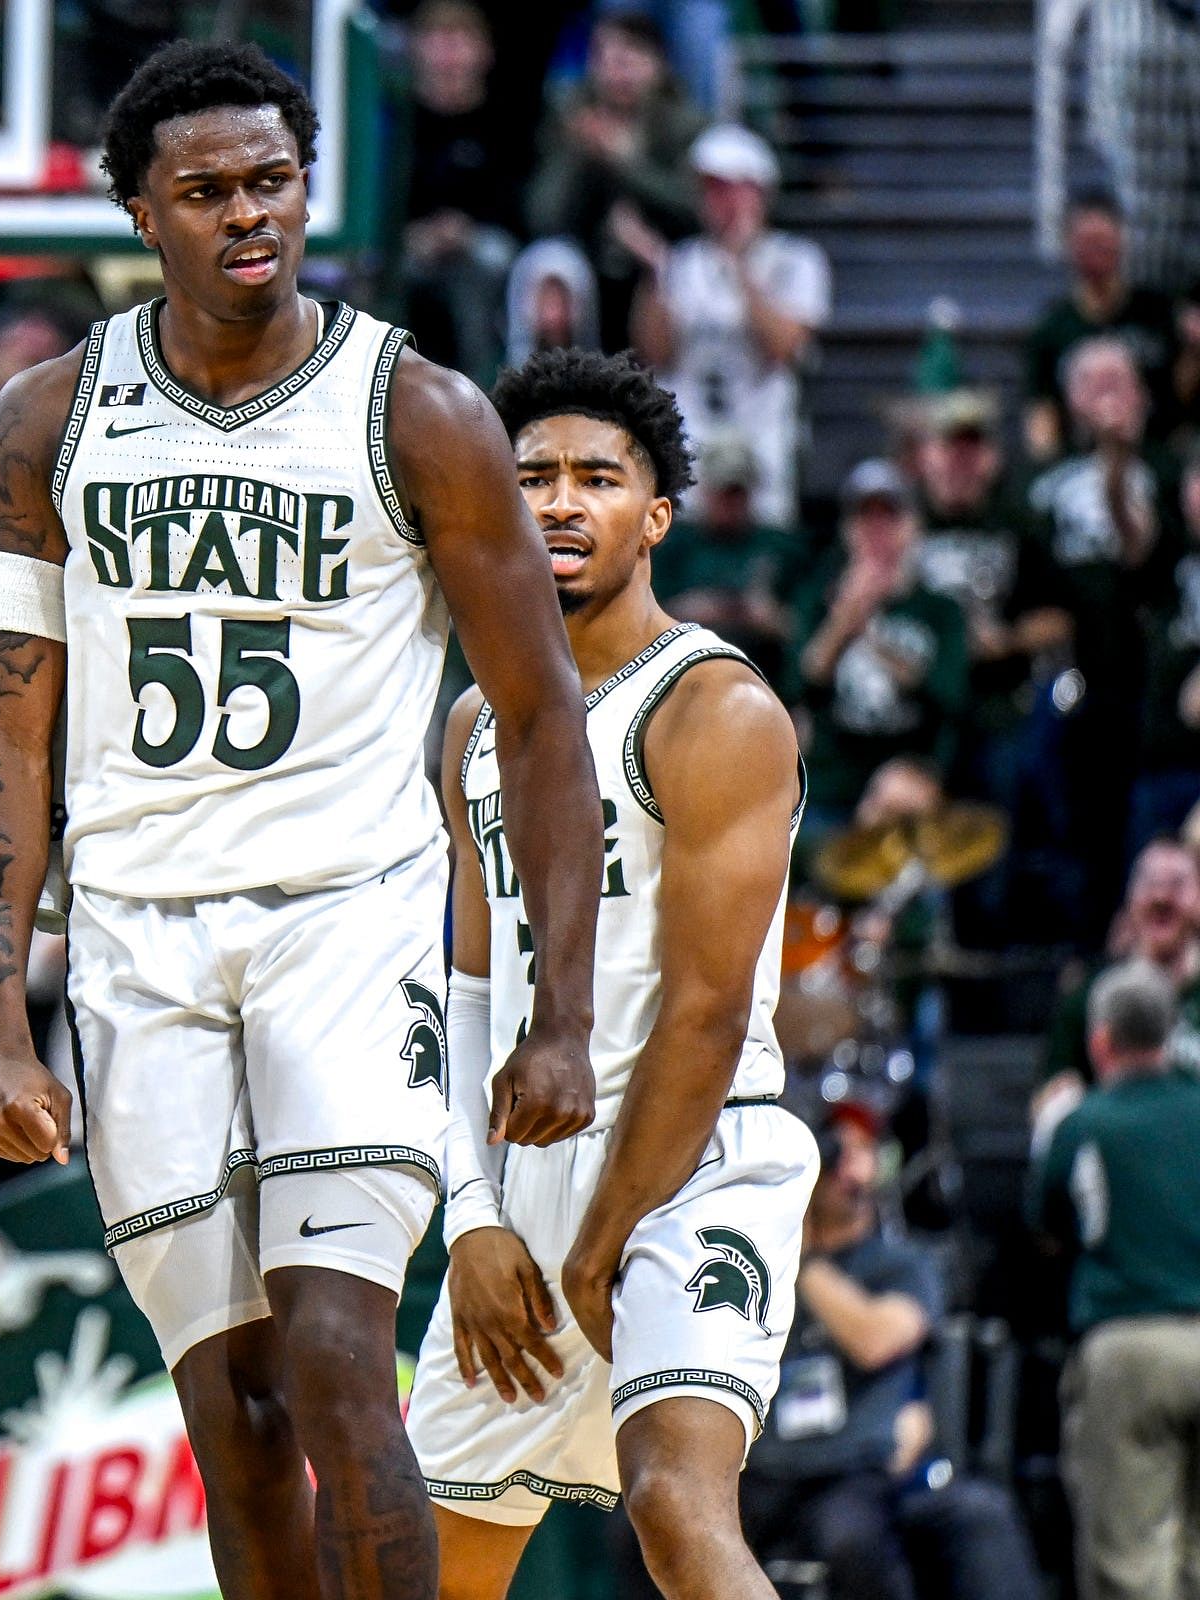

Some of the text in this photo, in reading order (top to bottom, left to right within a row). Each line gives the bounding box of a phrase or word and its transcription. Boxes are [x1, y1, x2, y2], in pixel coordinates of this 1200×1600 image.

[108, 384, 138, 406] JF
[83, 482, 354, 601] STATE
[135, 477, 296, 525] MICHIGAN
[125, 612, 301, 771] 55
